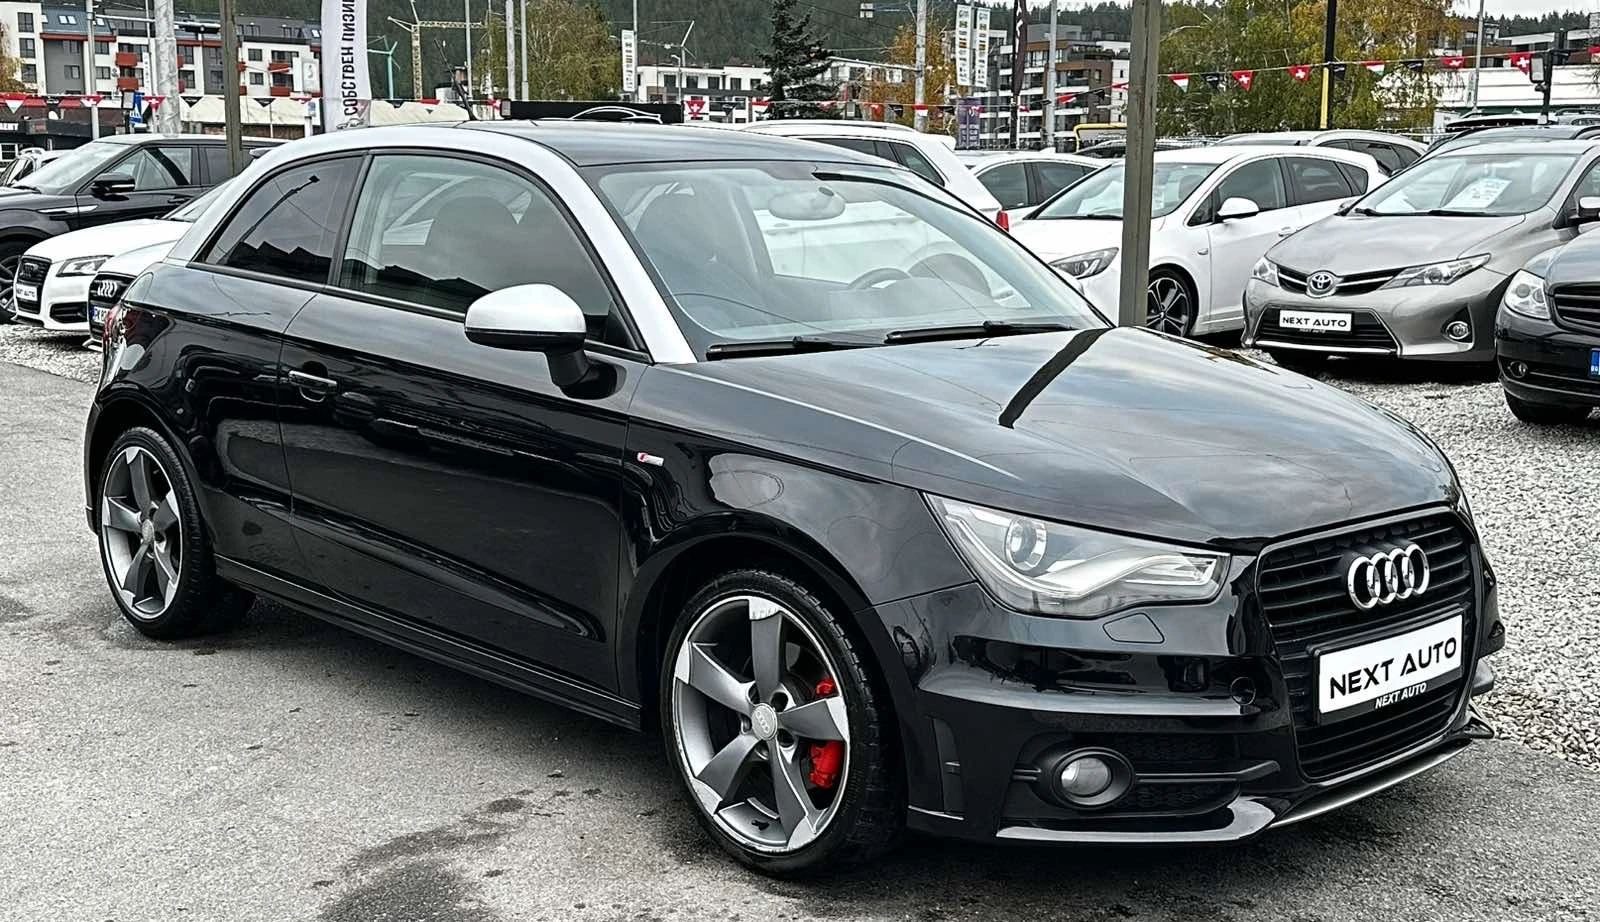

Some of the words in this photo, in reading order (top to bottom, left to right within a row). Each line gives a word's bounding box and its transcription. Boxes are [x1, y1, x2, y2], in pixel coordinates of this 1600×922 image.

[341, 0, 355, 41] ЛИЗИ
[341, 46, 358, 116] СОБСТВЕН
[1282, 316, 1310, 325] NEXT
[1312, 318, 1348, 328] AUTO
[1330, 658, 1394, 699] NEXT
[1400, 637, 1457, 677] AUTO
[1375, 690, 1401, 709] NEXT
[1401, 682, 1427, 700] AUTO
